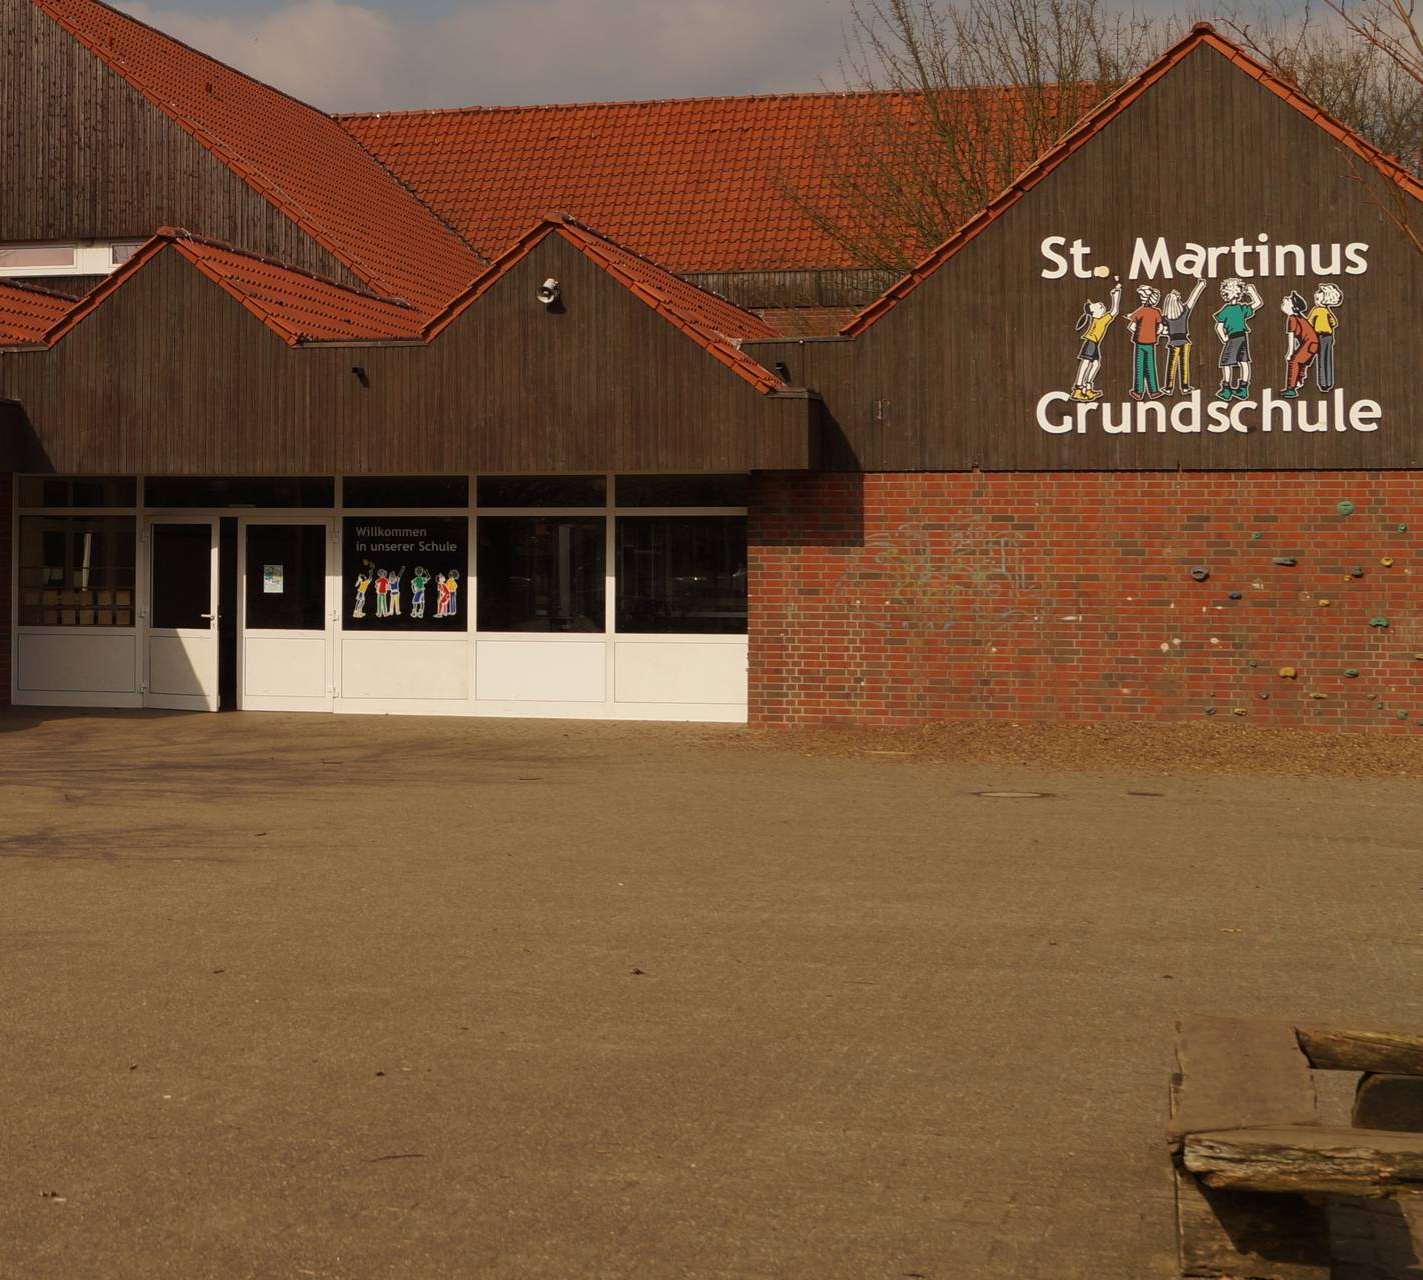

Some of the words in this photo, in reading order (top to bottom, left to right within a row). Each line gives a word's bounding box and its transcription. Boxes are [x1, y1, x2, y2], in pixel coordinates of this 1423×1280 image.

[1040, 235, 1110, 280] St.
[1128, 232, 1370, 280] Martinus
[1035, 388, 1382, 435] Grundschule
[355, 526, 427, 537] Willkommen
[356, 541, 367, 552] in
[370, 542, 416, 552] unserer
[418, 540, 458, 552] Schule
